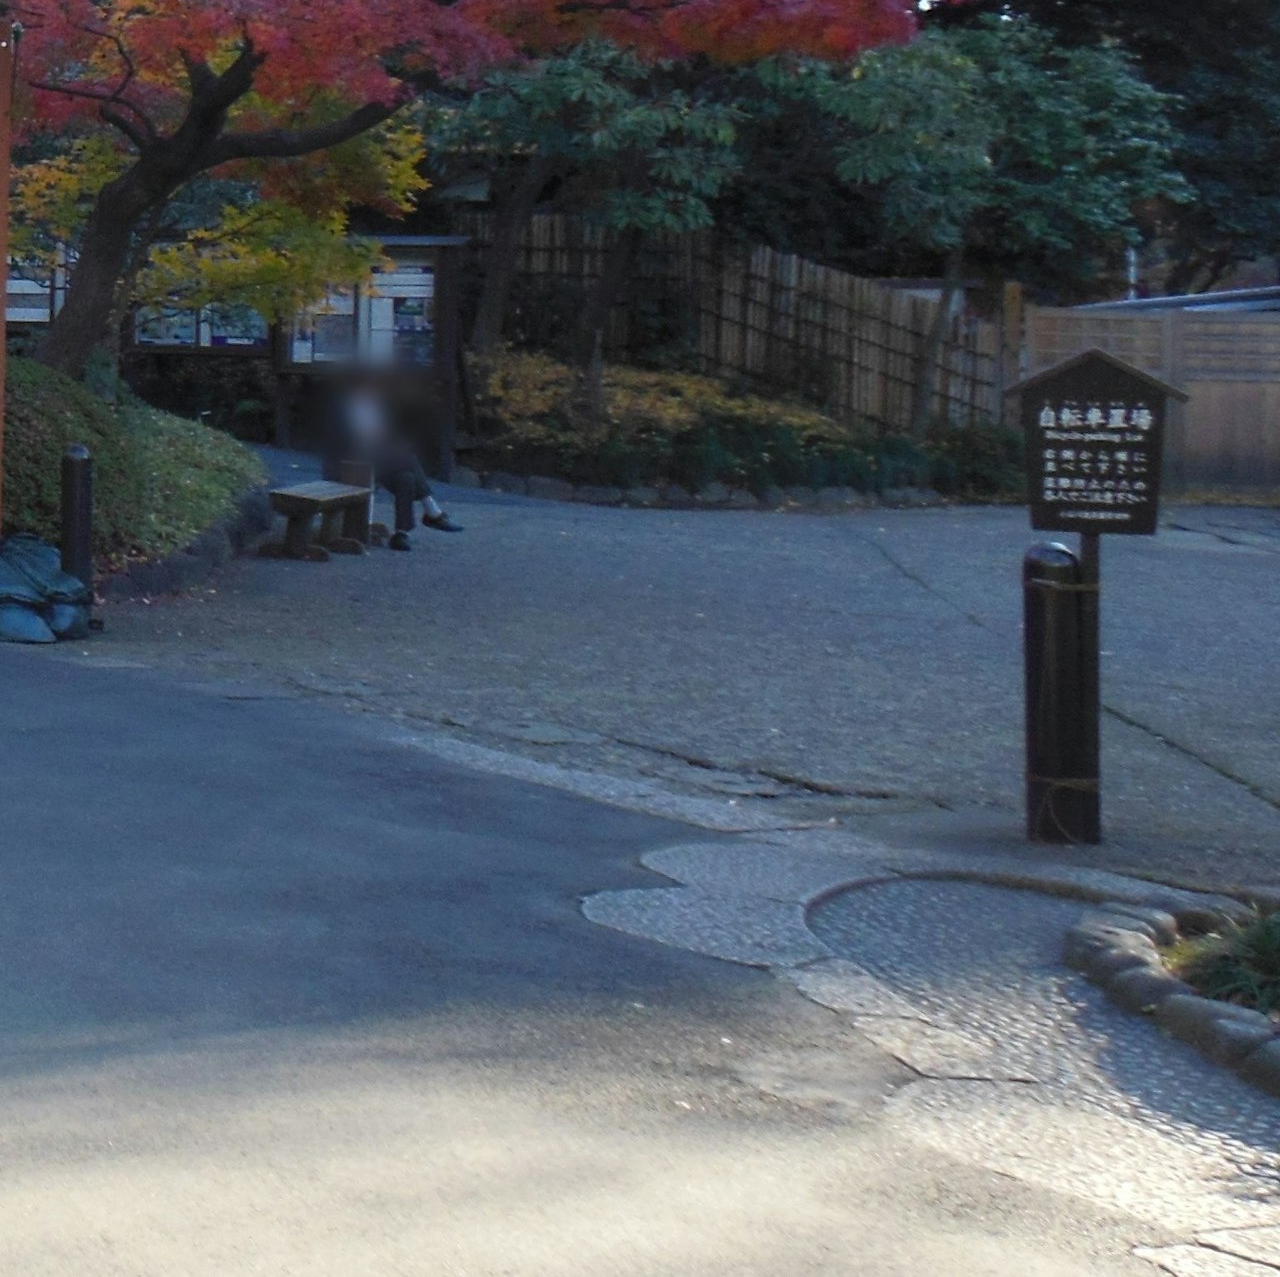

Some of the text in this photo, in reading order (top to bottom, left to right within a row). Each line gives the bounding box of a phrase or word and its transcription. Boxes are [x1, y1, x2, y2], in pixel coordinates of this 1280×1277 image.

[1039, 406, 1153, 430] 自転車置場
